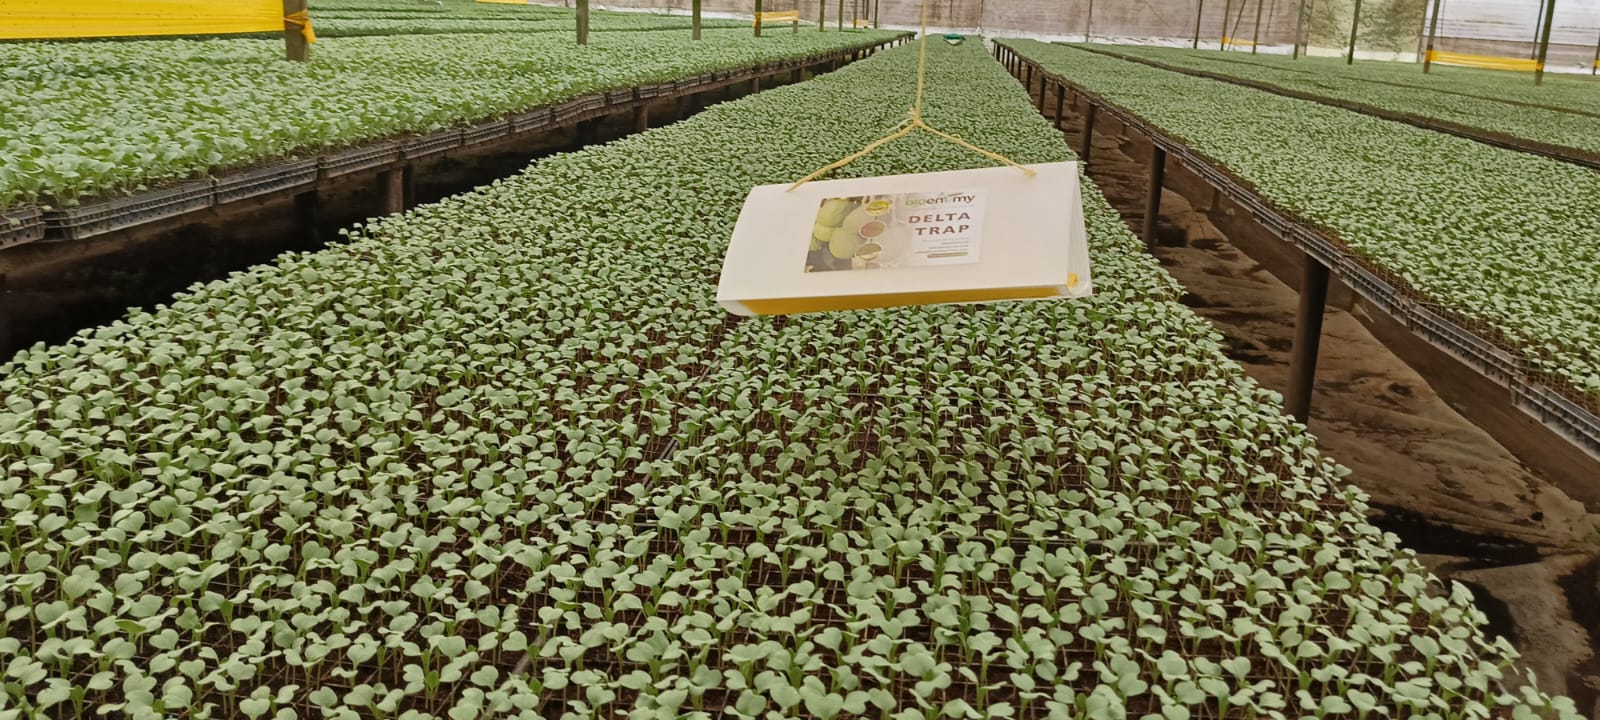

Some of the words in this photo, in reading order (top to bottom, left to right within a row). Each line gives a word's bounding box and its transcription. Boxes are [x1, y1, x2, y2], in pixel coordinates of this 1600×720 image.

[904, 194, 975, 206] bioenmy
[908, 212, 970, 224] DELTA
[915, 225, 969, 236] TRAP
